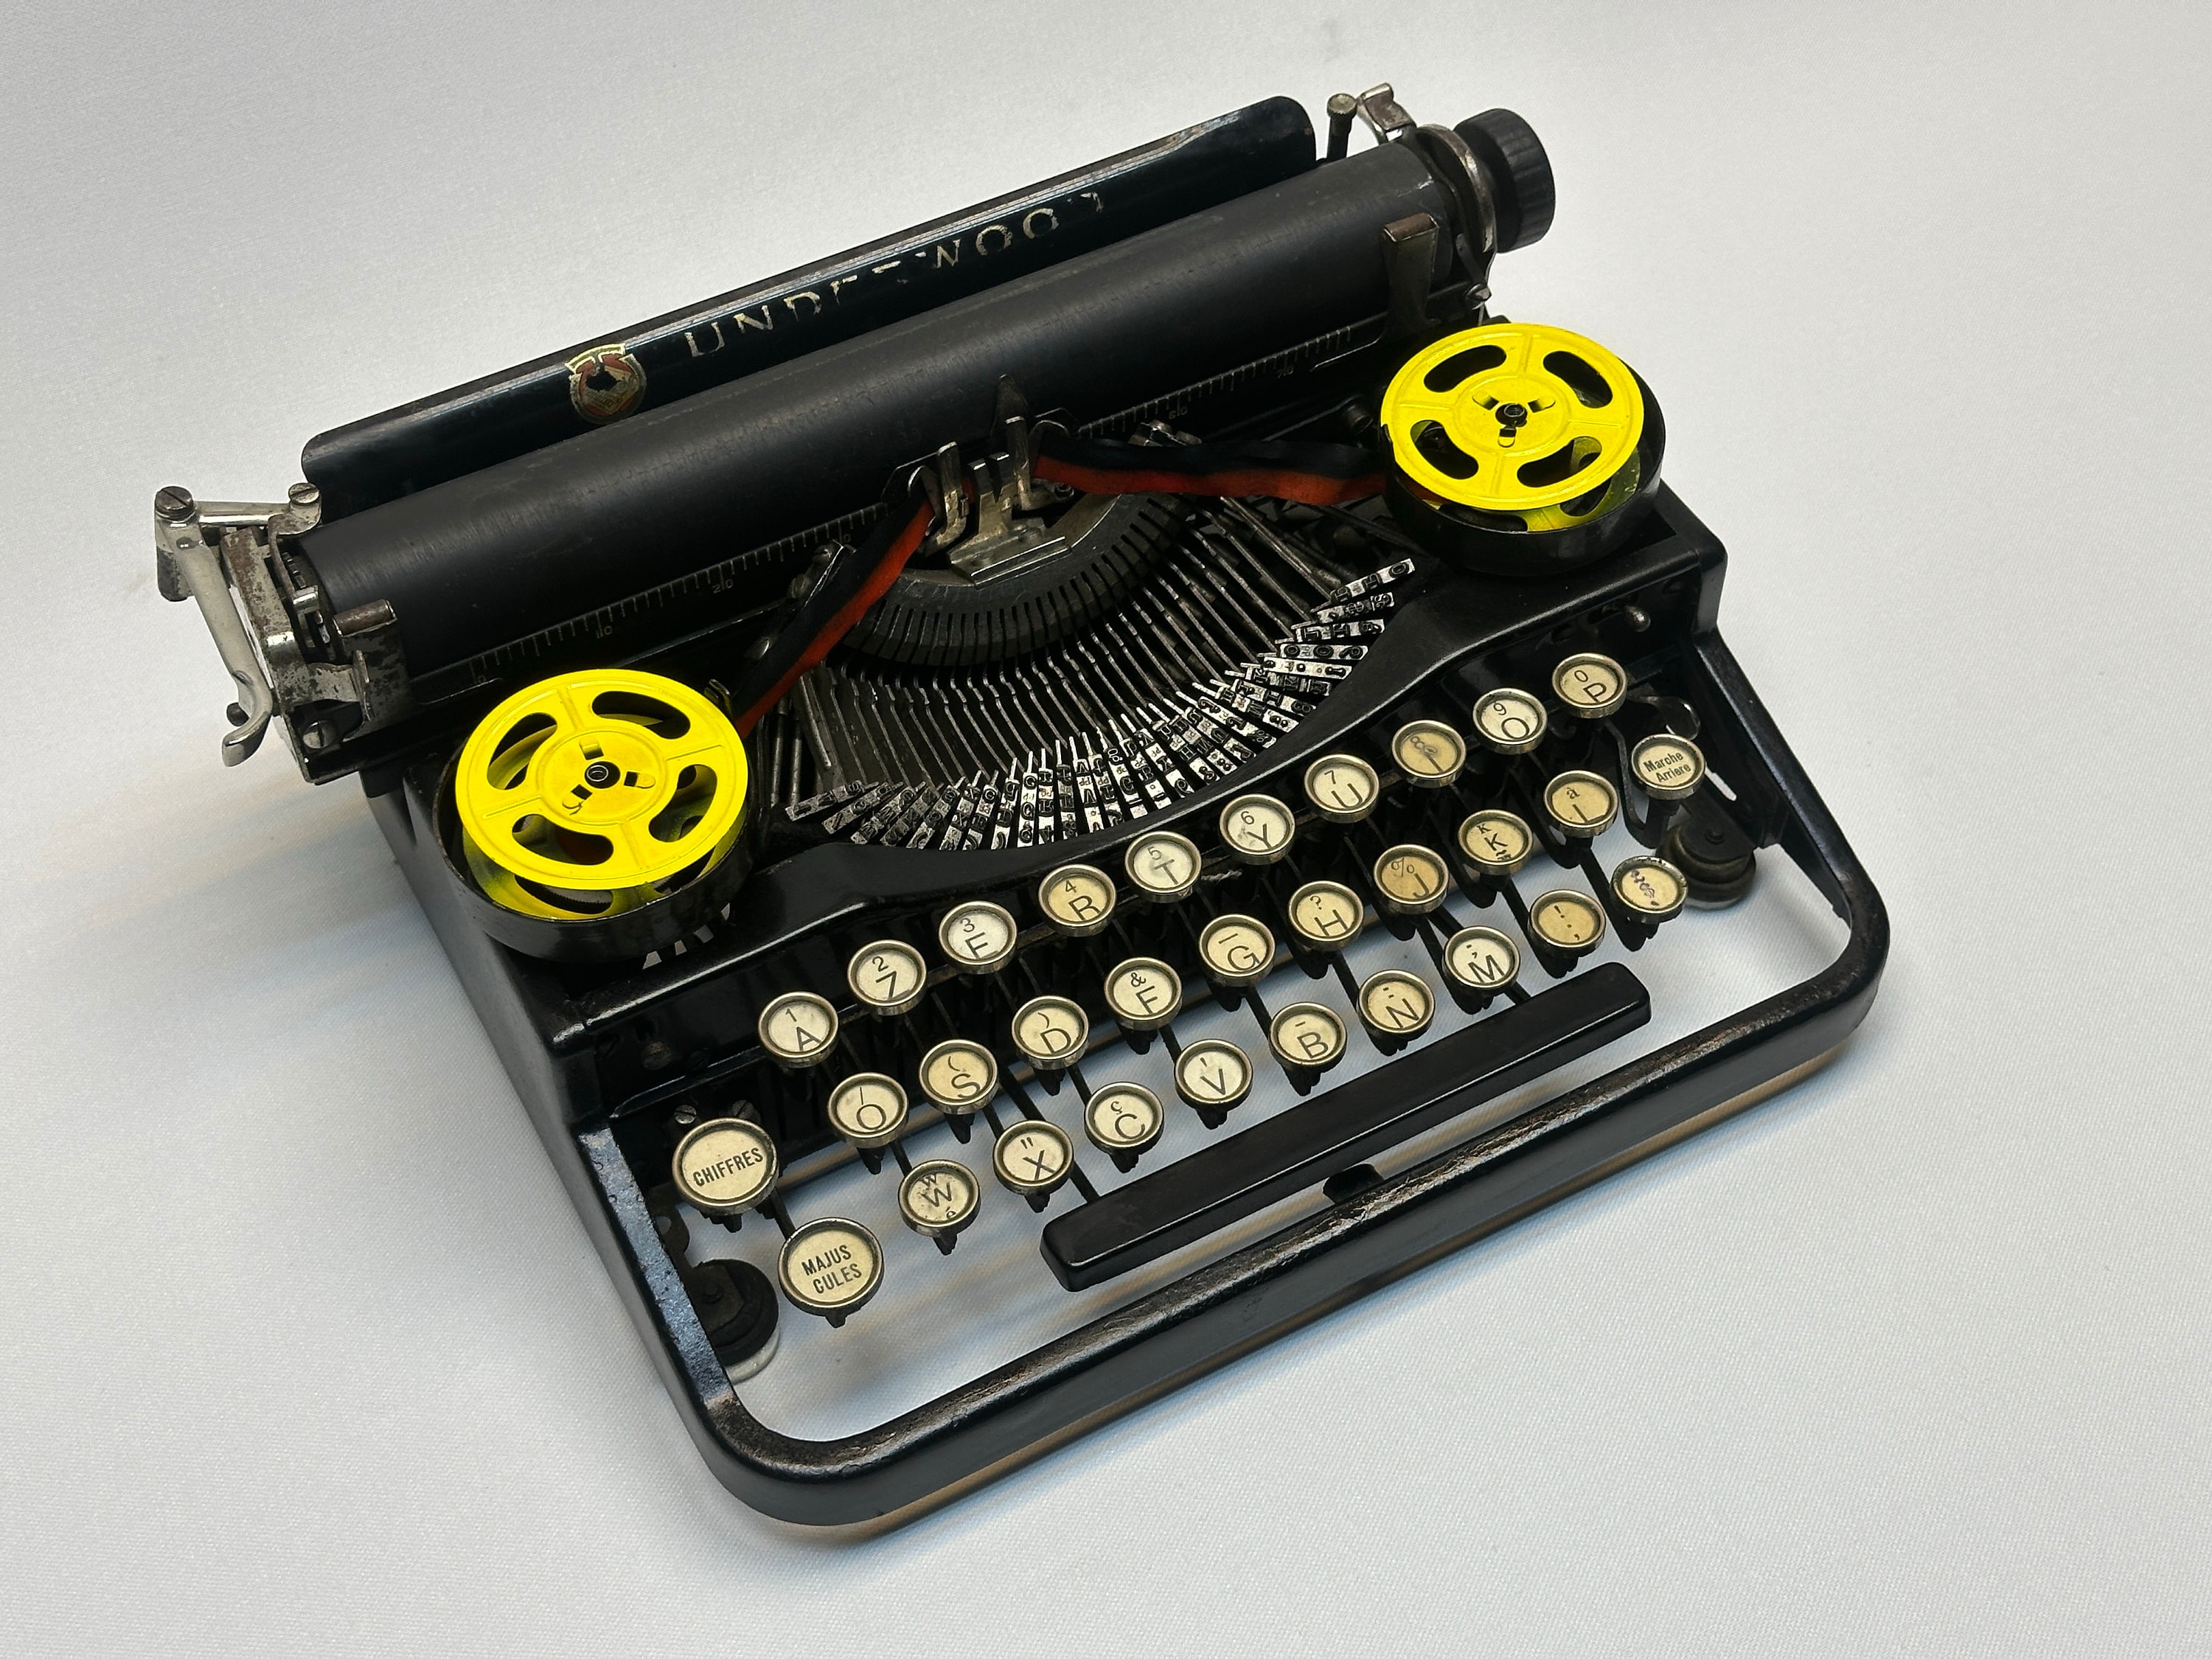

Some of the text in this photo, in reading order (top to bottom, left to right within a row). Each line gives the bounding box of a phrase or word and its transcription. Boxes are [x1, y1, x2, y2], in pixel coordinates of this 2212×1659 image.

[1582, 683, 1607, 703] P
[1492, 702, 1507, 716] 9
[1409, 736, 1425, 749] 8
[1643, 752, 1683, 773] Marche
[1324, 769, 1336, 785] 7
[1331, 782, 1363, 810] U
[1240, 810, 1255, 825] 6
[1247, 824, 1272, 849] Y
[1147, 846, 1162, 861] 5
[1153, 858, 1180, 886] T
[1391, 857, 1416, 877] %
[1064, 880, 1077, 894] 4
[1412, 872, 1430, 898] J
[1068, 894, 1100, 921] R
[1310, 894, 1323, 910] ?
[960, 917, 975, 933] 3
[1314, 908, 1349, 936] H
[872, 955, 889, 972] 2
[1227, 945, 1262, 971] G
[1467, 953, 1506, 983] M
[1130, 972, 1147, 987] &
[1135, 985, 1158, 1015] F
[785, 1008, 797, 1023] 1
[1385, 998, 1421, 1029] N
[796, 1026, 823, 1051] A
[1040, 1027, 1072, 1054] D
[1296, 1031, 1329, 1060] B
[950, 1072, 981, 1099] S
[1200, 1068, 1226, 1096] V
[1114, 1113, 1146, 1140] C
[692, 1147, 765, 1188] CHIFFRES
[1022, 1149, 1057, 1180] X
[801, 1244, 852, 1276] MAJUS
[812, 1263, 863, 1295] CULES
